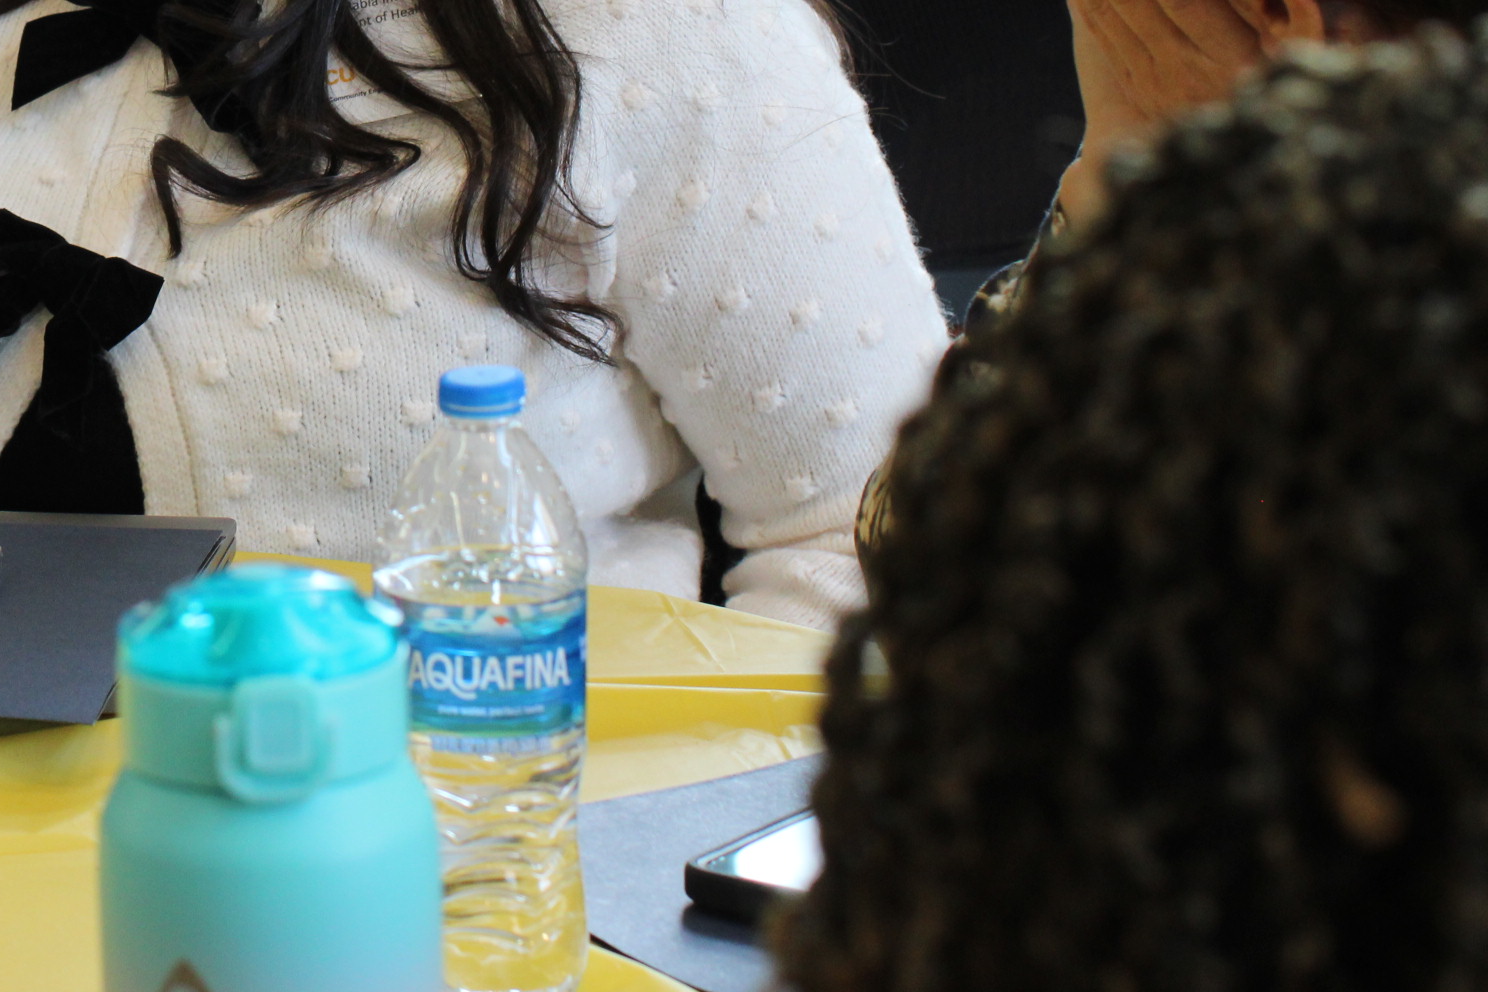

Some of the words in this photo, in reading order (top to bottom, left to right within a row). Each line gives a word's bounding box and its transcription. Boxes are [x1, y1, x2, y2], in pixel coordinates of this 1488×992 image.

[375, 10, 387, 23] of
[326, 67, 356, 85] CU
[409, 646, 572, 701] AQUAFINA
